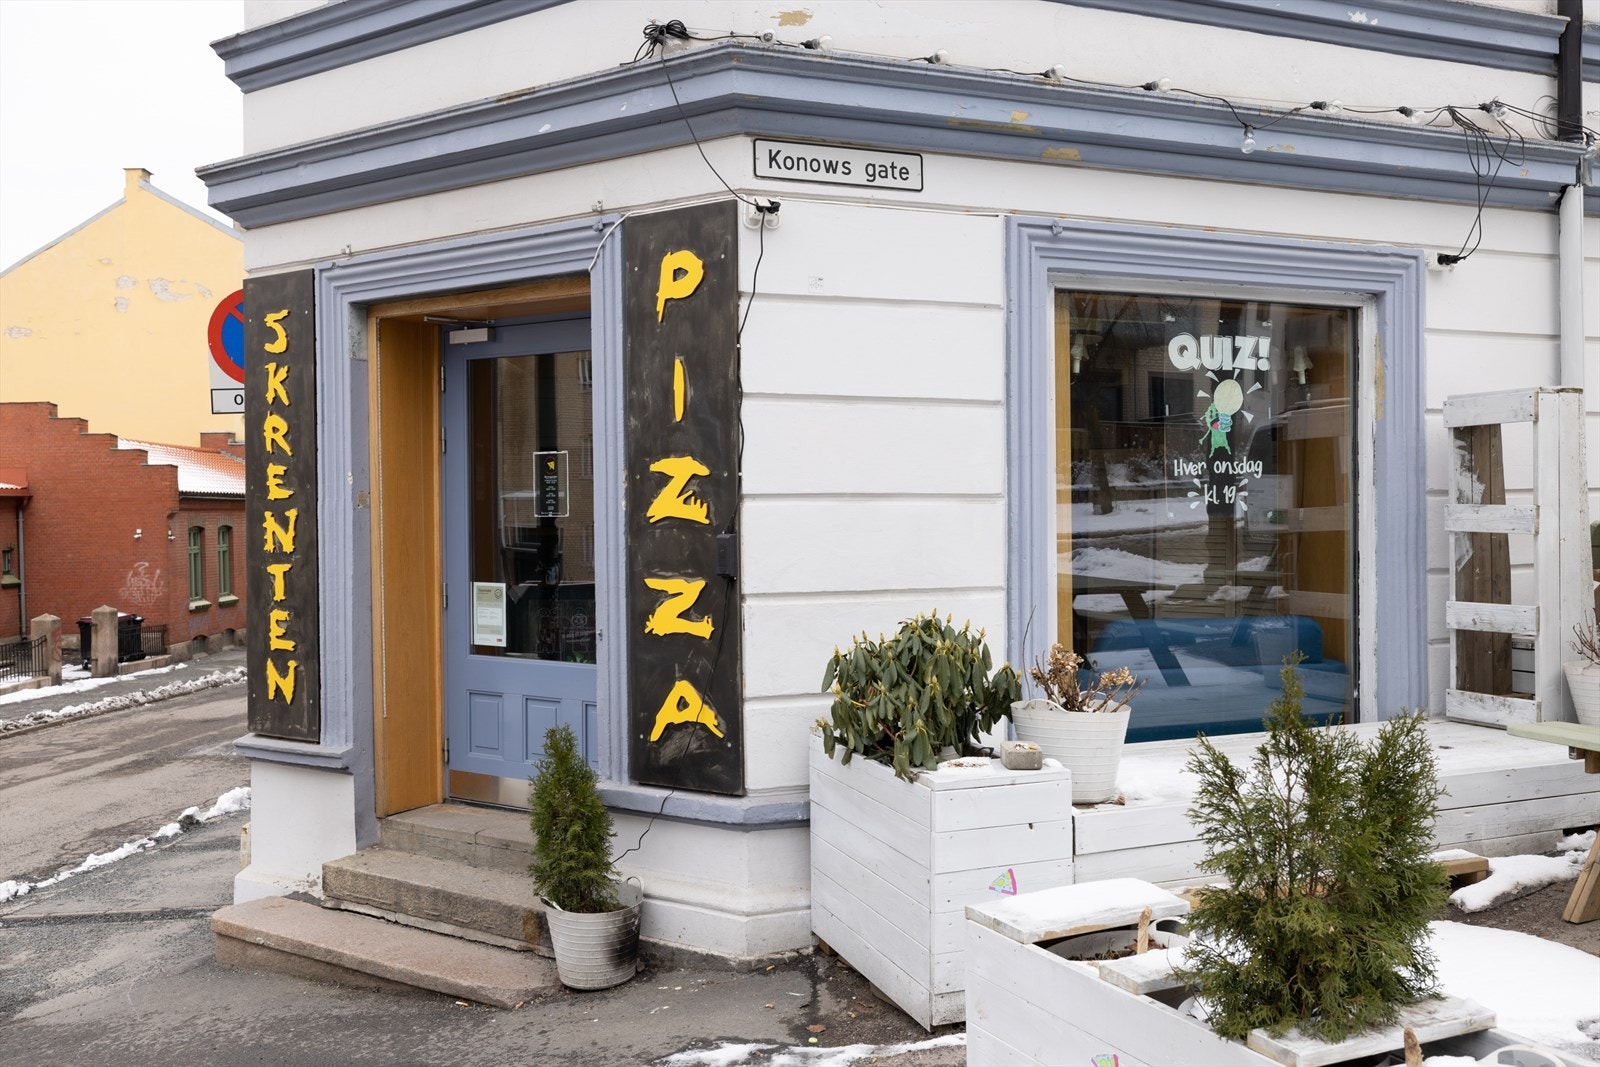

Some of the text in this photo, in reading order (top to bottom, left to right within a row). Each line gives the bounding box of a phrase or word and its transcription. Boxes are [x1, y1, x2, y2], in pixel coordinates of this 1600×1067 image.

[768, 148, 911, 184] Konows gate
[1167, 332, 1271, 371] QUIZ!
[1173, 456, 1263, 479] Hver onsdag
[262, 309, 298, 704] SKRENTEN
[644, 249, 724, 742] PIZZA
[1223, 485, 1237, 504] 19
